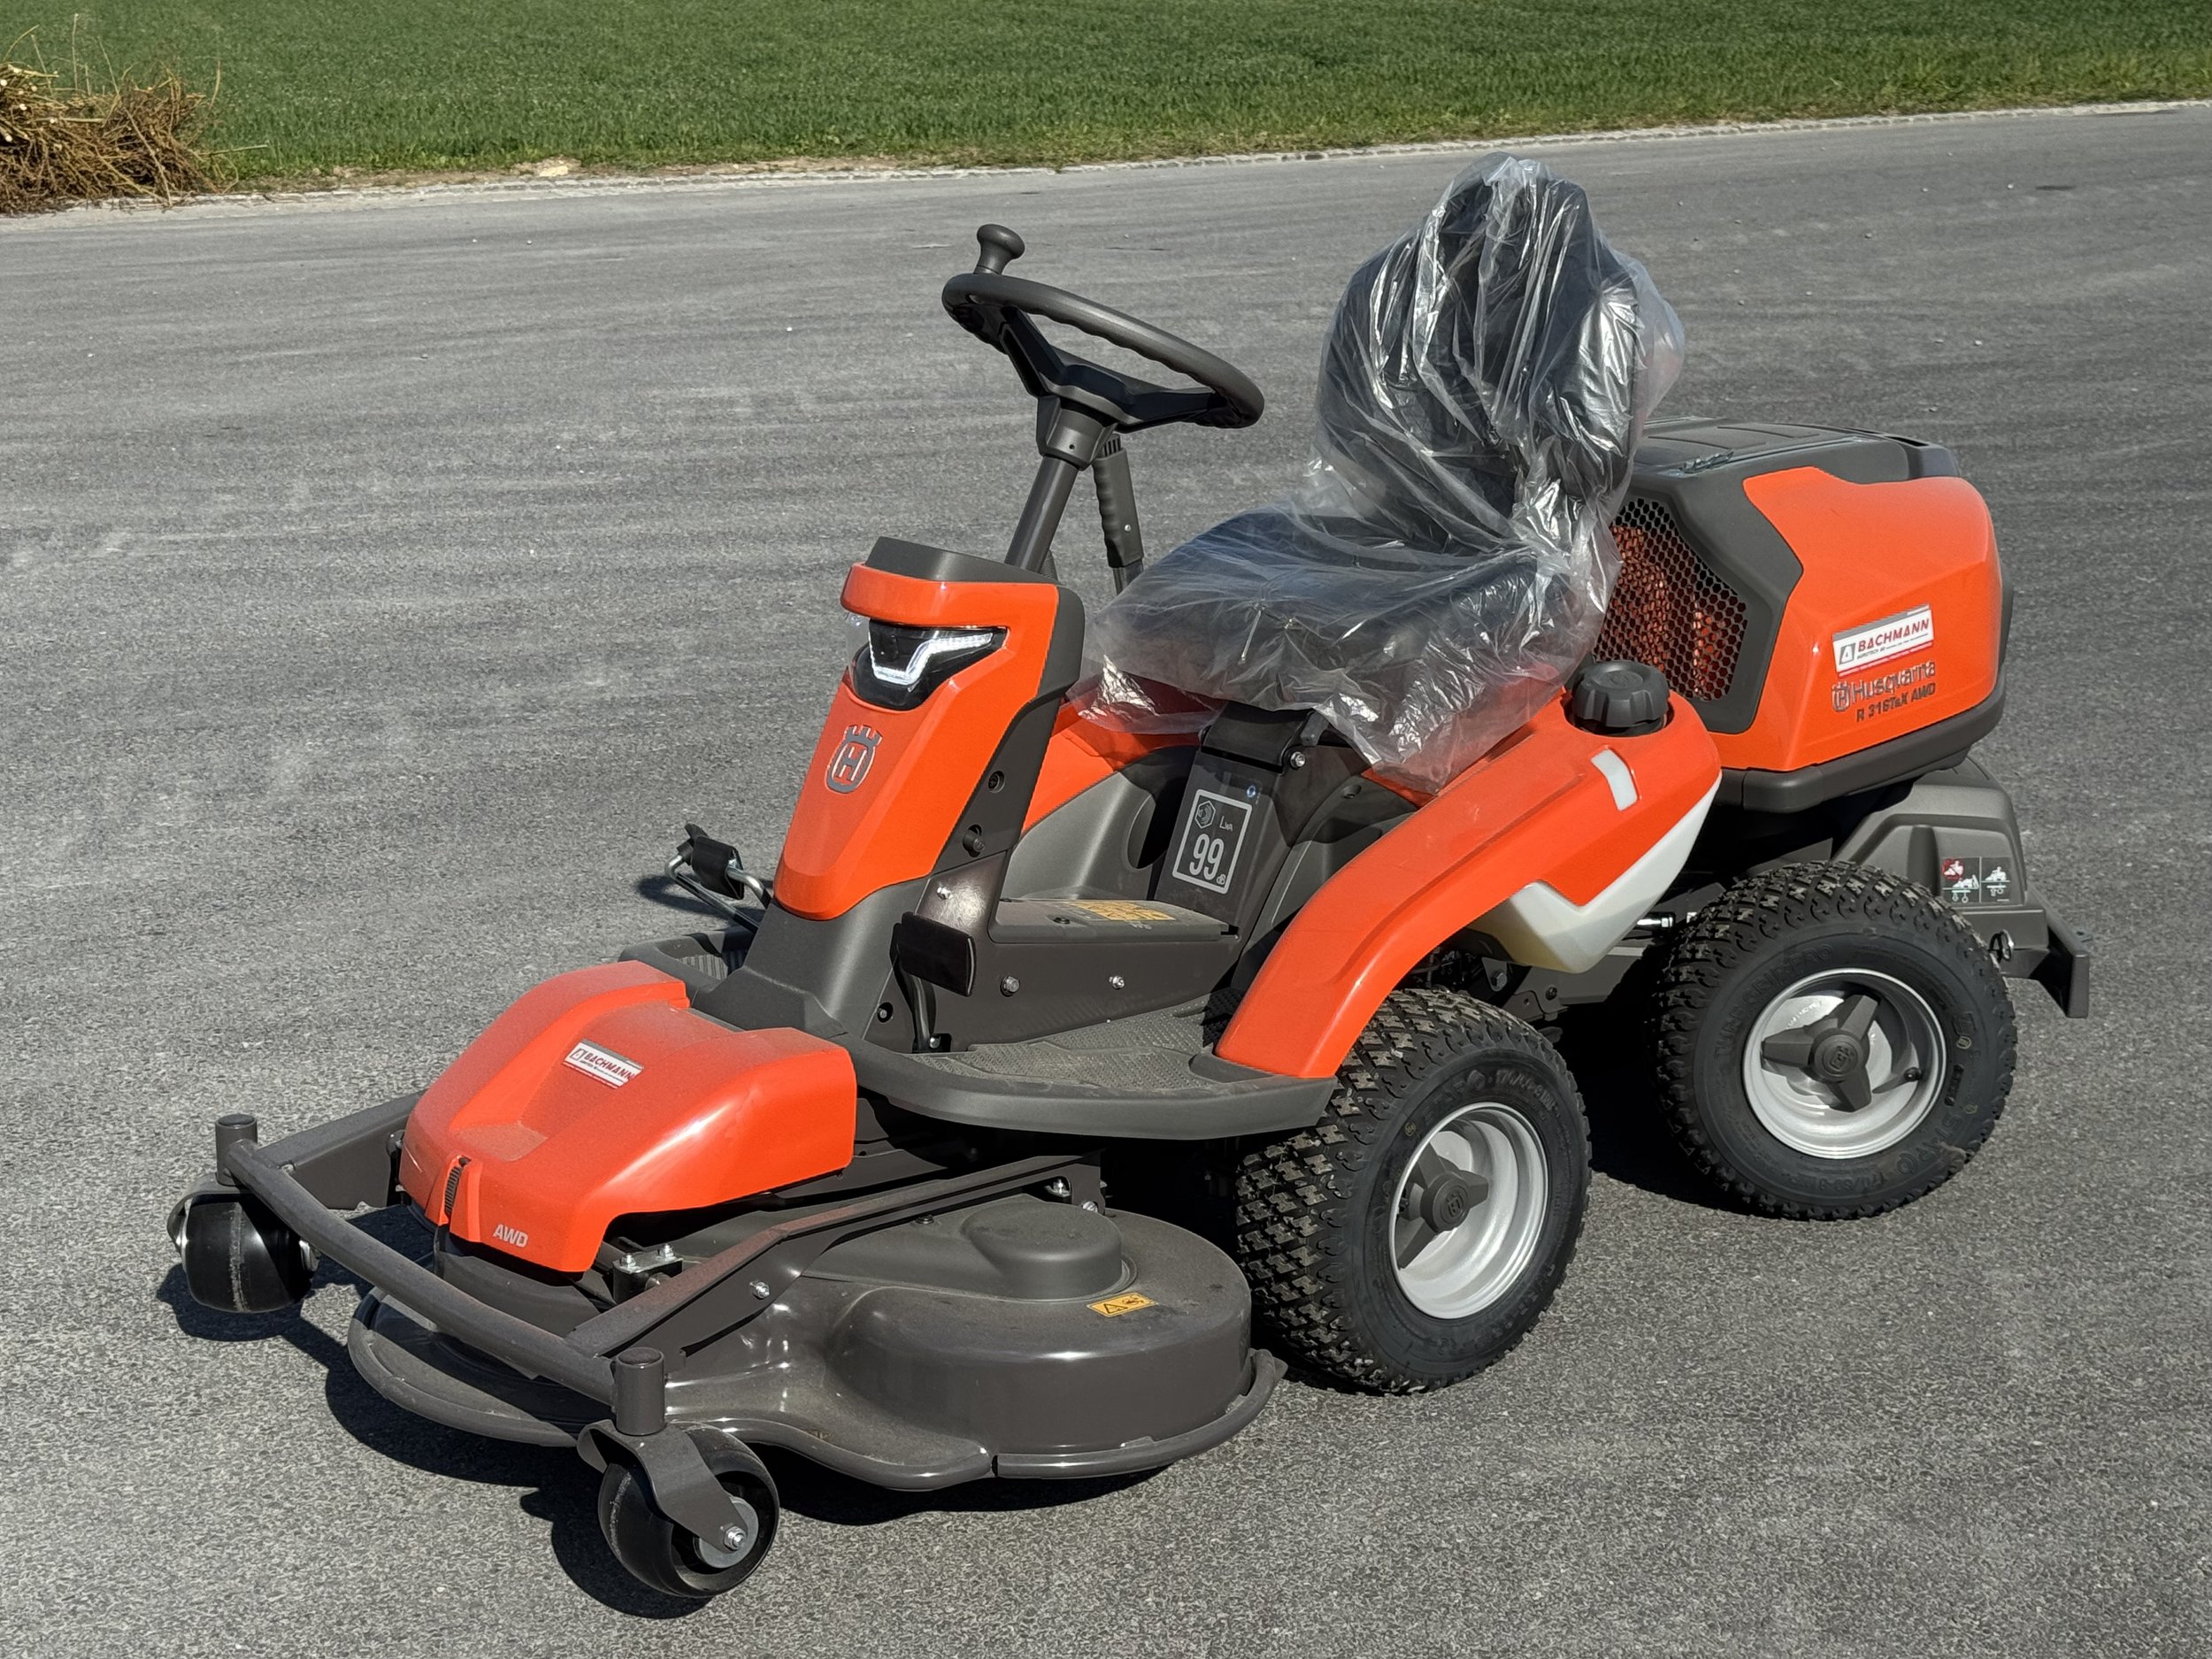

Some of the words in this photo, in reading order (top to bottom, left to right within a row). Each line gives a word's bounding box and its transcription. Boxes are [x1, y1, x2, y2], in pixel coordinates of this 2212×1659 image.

[1857, 618, 1930, 653] BACHMANN
[1851, 661, 1936, 703] Husqvarna
[1856, 709, 1864, 722] R
[1911, 682, 1936, 702] AWD
[1189, 833, 1225, 880] 99
[583, 1052, 635, 1079] BACHMANN
[492, 1224, 528, 1248] AWD
